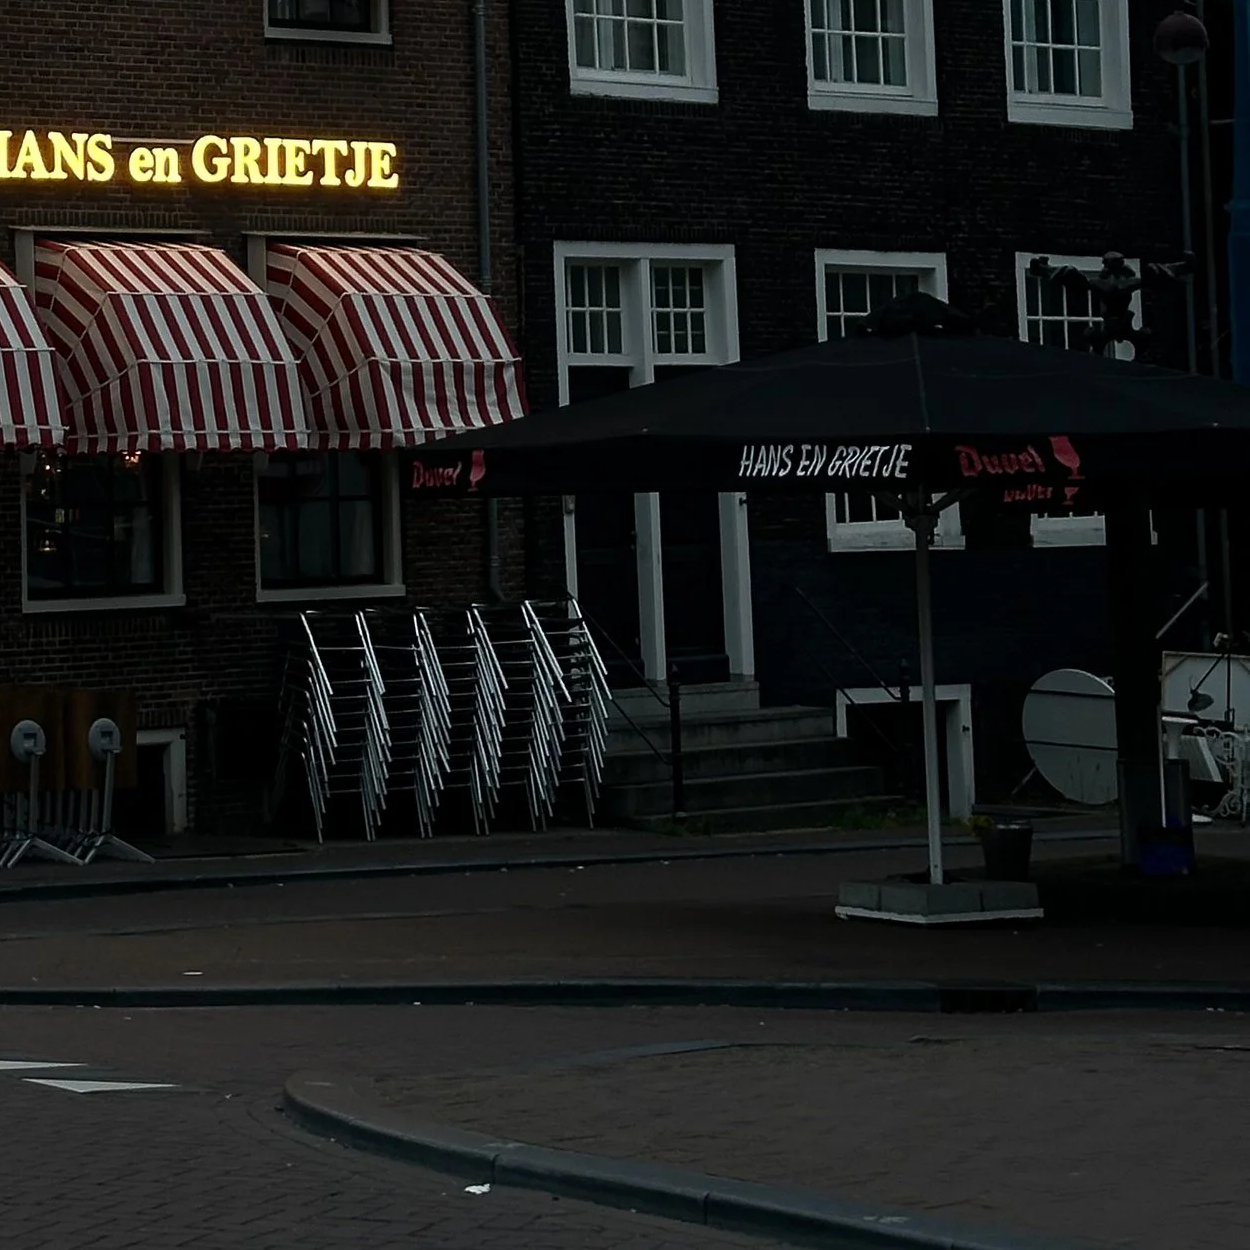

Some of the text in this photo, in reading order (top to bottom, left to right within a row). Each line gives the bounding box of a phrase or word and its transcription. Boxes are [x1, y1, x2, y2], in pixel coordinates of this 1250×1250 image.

[128, 146, 181, 182] en
[192, 135, 399, 188] GRIETJE
[412, 460, 463, 490] Duvel
[738, 443, 913, 479] HANS EN GRIETJE
[954, 443, 1046, 478] Duvel
